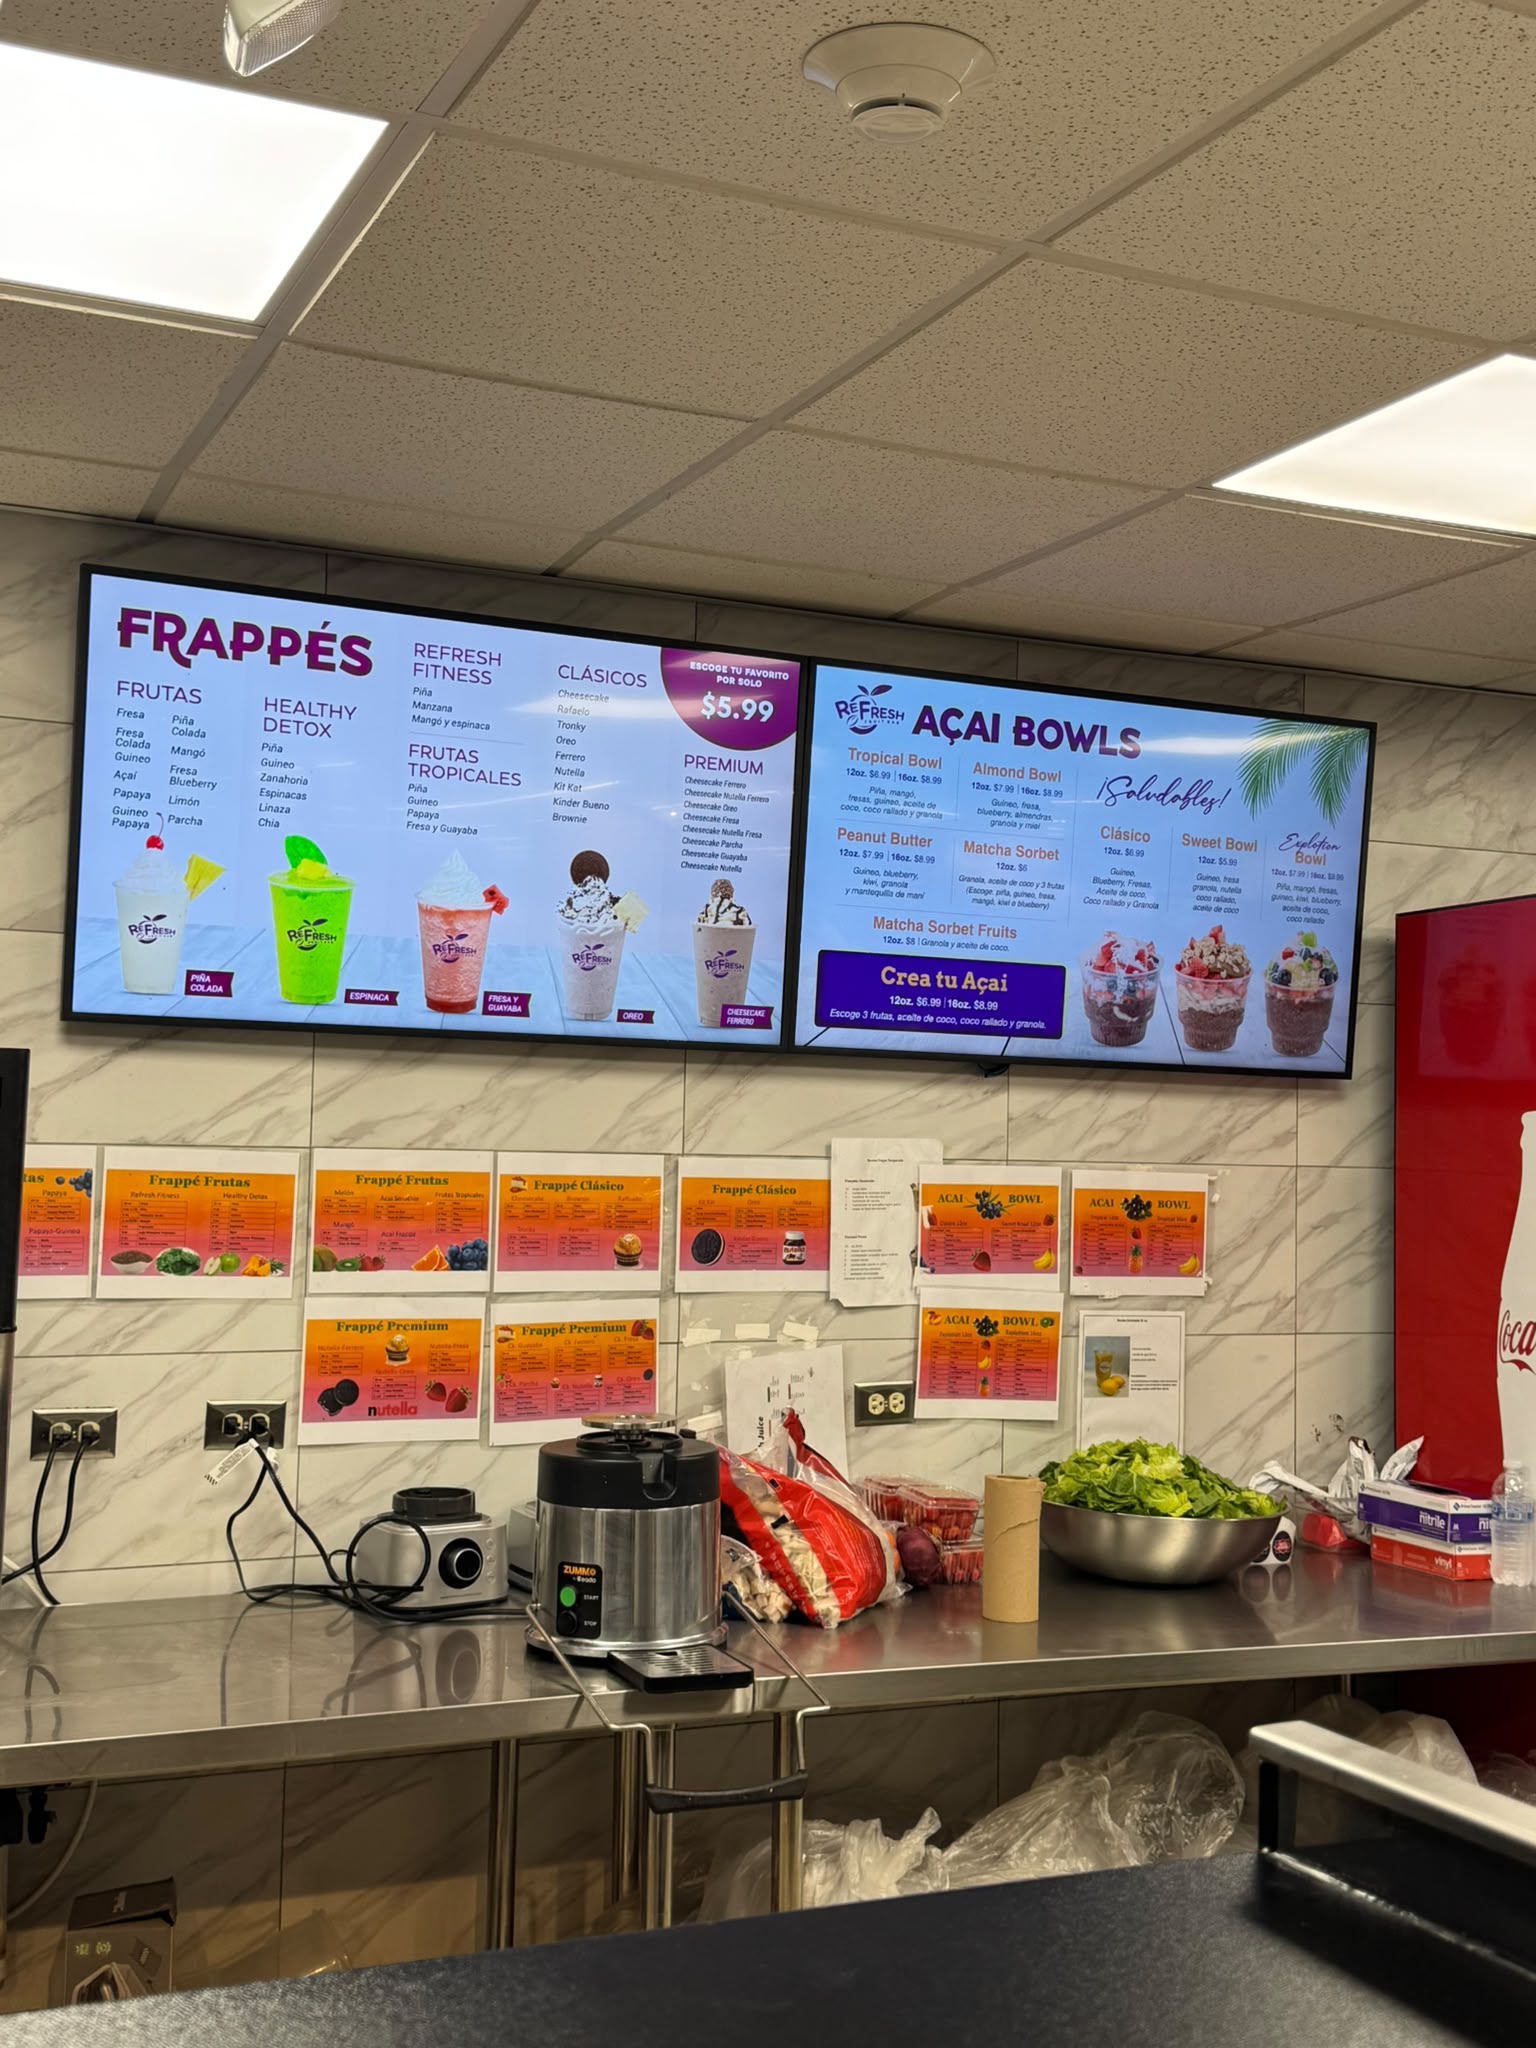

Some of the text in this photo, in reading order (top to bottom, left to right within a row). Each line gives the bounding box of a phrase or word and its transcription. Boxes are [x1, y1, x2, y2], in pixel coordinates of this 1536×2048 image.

[117, 607, 373, 676] FRAPPÉS
[414, 643, 502, 666] REFRESH
[413, 663, 492, 685] FITNESS
[558, 665, 647, 688] CLÁSICOS
[690, 661, 789, 680] ESCOGE TU FAVORITO
[716, 675, 762, 688] POR SOLO
[116, 680, 202, 704] FRUTAS
[412, 687, 432, 697] Piña
[558, 689, 609, 703] Cheesecake
[264, 697, 357, 720] HEALTHY
[412, 700, 452, 712] Manzana
[701, 691, 774, 722] $5.99
[116, 707, 145, 719] Fresa
[172, 715, 194, 726] Piña
[412, 714, 442, 726] Mangó
[452, 720, 490, 730] espinaca
[557, 720, 586, 733] Tronky
[116, 727, 144, 738] Fresa
[172, 726, 206, 738] Colada
[263, 717, 332, 738] DETOX
[912, 705, 1142, 759] AÇAI BOWLS
[115, 738, 150, 750] Colada
[556, 736, 576, 746] Oreo
[170, 746, 206, 759] Mangó
[261, 742, 283, 754] Piña
[409, 744, 479, 764] FRUTAS
[114, 752, 151, 764] Guineo
[555, 751, 586, 762] Ferrero
[848, 747, 942, 769] Tropical Bowl
[170, 764, 198, 776] Fresa
[260, 758, 295, 770] Guineo
[684, 754, 764, 776] PREMIUM
[113, 770, 138, 781] Açaí
[408, 762, 522, 787] TROPICALES
[554, 767, 585, 777] Nutella
[846, 768, 942, 784] 12oz. $6.99 16oz. $8.99
[973, 762, 1062, 782] Almond Bowl
[169, 776, 217, 790] Blueberry
[260, 773, 308, 786] Zanahoria
[408, 784, 428, 794] Piña
[554, 782, 565, 791] Kit
[972, 782, 1063, 798] 12oz. $7.99 16oz. $8.99
[113, 788, 151, 800] Papaya
[259, 788, 307, 802] Espinacas
[1096, 774, 1232, 815] ¡Saludables!
[168, 796, 200, 806] Limón
[408, 796, 438, 806] Guineo
[553, 798, 610, 810] Kinder Bueno
[112, 806, 148, 817] Guineo
[258, 803, 291, 815] Linaza
[407, 808, 440, 820] Papaya
[112, 817, 150, 830] Papaya
[168, 814, 203, 826] Parcha
[258, 818, 280, 829] Chia
[552, 812, 587, 824] Brownie
[406, 821, 430, 832] Fresa
[440, 822, 478, 836] Guayaba
[1100, 825, 1151, 844] Clásico
[837, 827, 933, 848] Peanut Butter
[1182, 833, 1258, 852] Sweet Bowl
[840, 848, 936, 864] 12oz. $7.99 16oz. $8.99
[963, 840, 1060, 860] Matcha Sorbet
[1104, 847, 1123, 856] 12oz.
[720, 852, 748, 862] Guayaba
[1198, 856, 1238, 866] 12oz. $5.99
[1294, 851, 1327, 866] Bowl
[720, 864, 742, 873] Nutella
[996, 862, 1028, 872] 12oz. $6
[872, 916, 1018, 940] Matcha Sorbet Fruits
[190, 973, 211, 984] PIÑA
[880, 966, 1008, 995] Crea tu Açai
[190, 984, 224, 993] COLADA
[350, 992, 390, 1002] ESPINACA
[488, 994, 520, 1004] FRESA Y
[889, 996, 999, 1011] 12oz. $6.99 16oz. $8.99
[488, 1004, 522, 1012] GUAYABA
[622, 1012, 644, 1021] OREO
[830, 1008, 860, 1020] Escoge
[870, 1010, 895, 1022] frutas,
[897, 1013, 921, 1023] aceite
[923, 1014, 934, 1023] de
[936, 1016, 958, 1026] coco,
[960, 1016, 980, 1026] coco
[982, 1017, 1008, 1028] rallado
[1009, 1020, 1016, 1030] y
[148, 1175, 250, 1189] Frappé Frutas
[356, 1174, 449, 1187] Frappé Frutas
[533, 1180, 624, 1192] Frappé Clásico
[712, 1184, 797, 1196] Frappé Clásico
[938, 1194, 1044, 1204] ACAI BOWL
[1090, 1198, 1191, 1209] ACAI BOWL
[944, 1315, 1038, 1326] ACAI BOWL
[336, 1321, 448, 1334] Frappé Premium
[521, 1322, 626, 1338] Frappé Premium
[368, 1402, 418, 1416] nutella
[756, 1416, 765, 1440] Juice
[1418, 1512, 1446, 1530] nitrile
[1434, 1556, 1452, 1570] vinyl
[563, 1564, 596, 1576] ZUMMO
